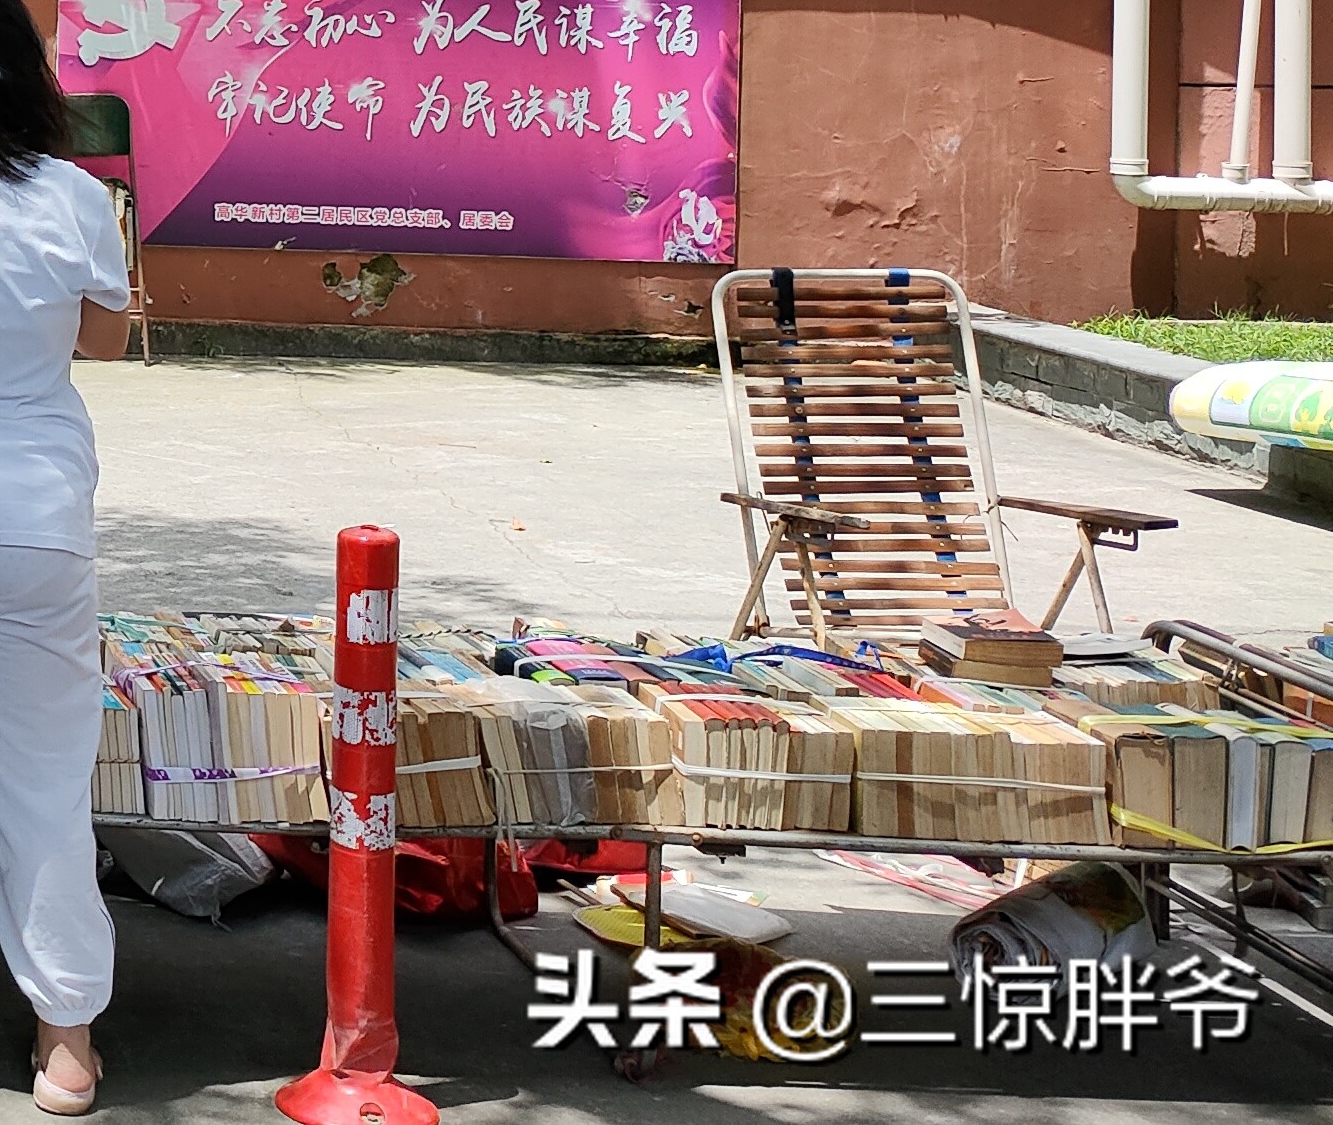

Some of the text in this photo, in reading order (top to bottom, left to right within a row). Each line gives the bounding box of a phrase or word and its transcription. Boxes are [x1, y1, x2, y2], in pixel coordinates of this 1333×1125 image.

[207, 70, 693, 144] 牢记使命 为民族谋复兴
[214, 203, 515, 231] 高华新村第二居民区党总支部、居委会
